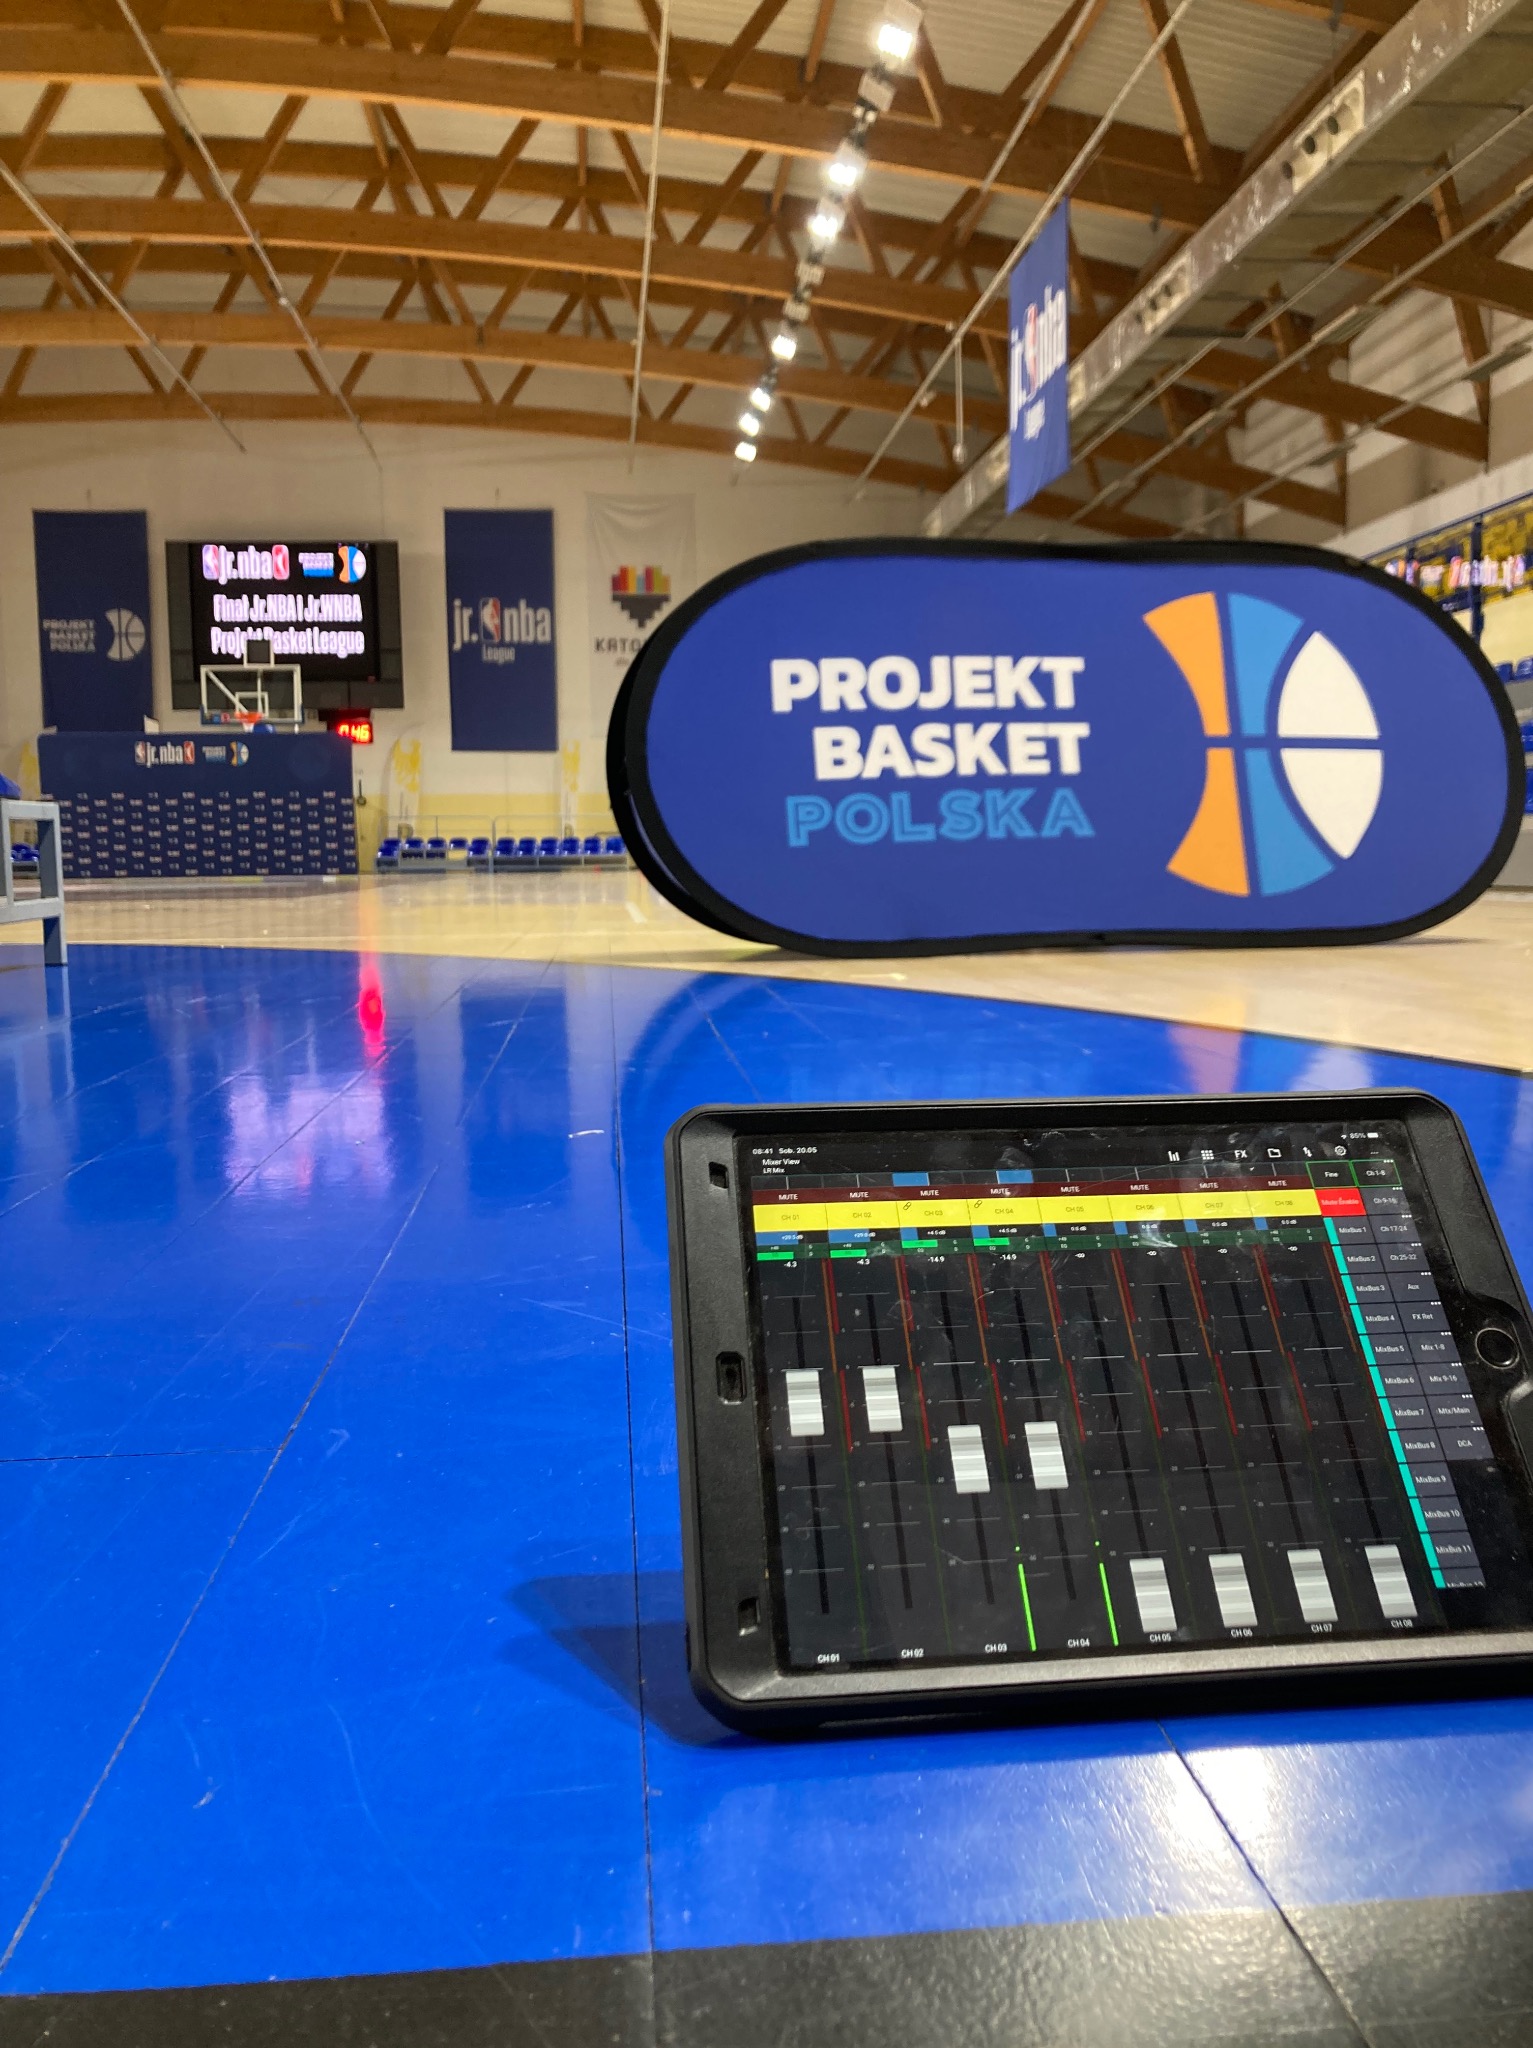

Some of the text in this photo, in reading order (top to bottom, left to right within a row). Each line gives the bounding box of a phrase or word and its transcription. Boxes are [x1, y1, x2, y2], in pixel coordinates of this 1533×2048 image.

[453, 598, 551, 651] jr. nba
[313, 627, 365, 658] League
[770, 655, 1085, 713] PROJEKT
[813, 722, 1090, 781] BASKET
[785, 787, 1096, 847] POLSKA
[1234, 1150, 1247, 1158] FX
[1395, 1409, 1419, 1417] MixBus
[1405, 1442, 1430, 1450] MixBus
[1416, 1476, 1440, 1484] MixBus
[1424, 1510, 1450, 1518] MixBus
[1435, 1546, 1463, 1554] MixBus
[1311, 1624, 1333, 1633] CH 07
[1391, 1619, 1413, 1628] CH 08
[1149, 1633, 1171, 1643] CH 05
[1231, 1628, 1253, 1638] CH 06
[985, 1643, 1008, 1653] CH 03
[1067, 1638, 1090, 1648] CH 04
[817, 1653, 840, 1663] CH 01
[901, 1648, 924, 1658] CH 02
